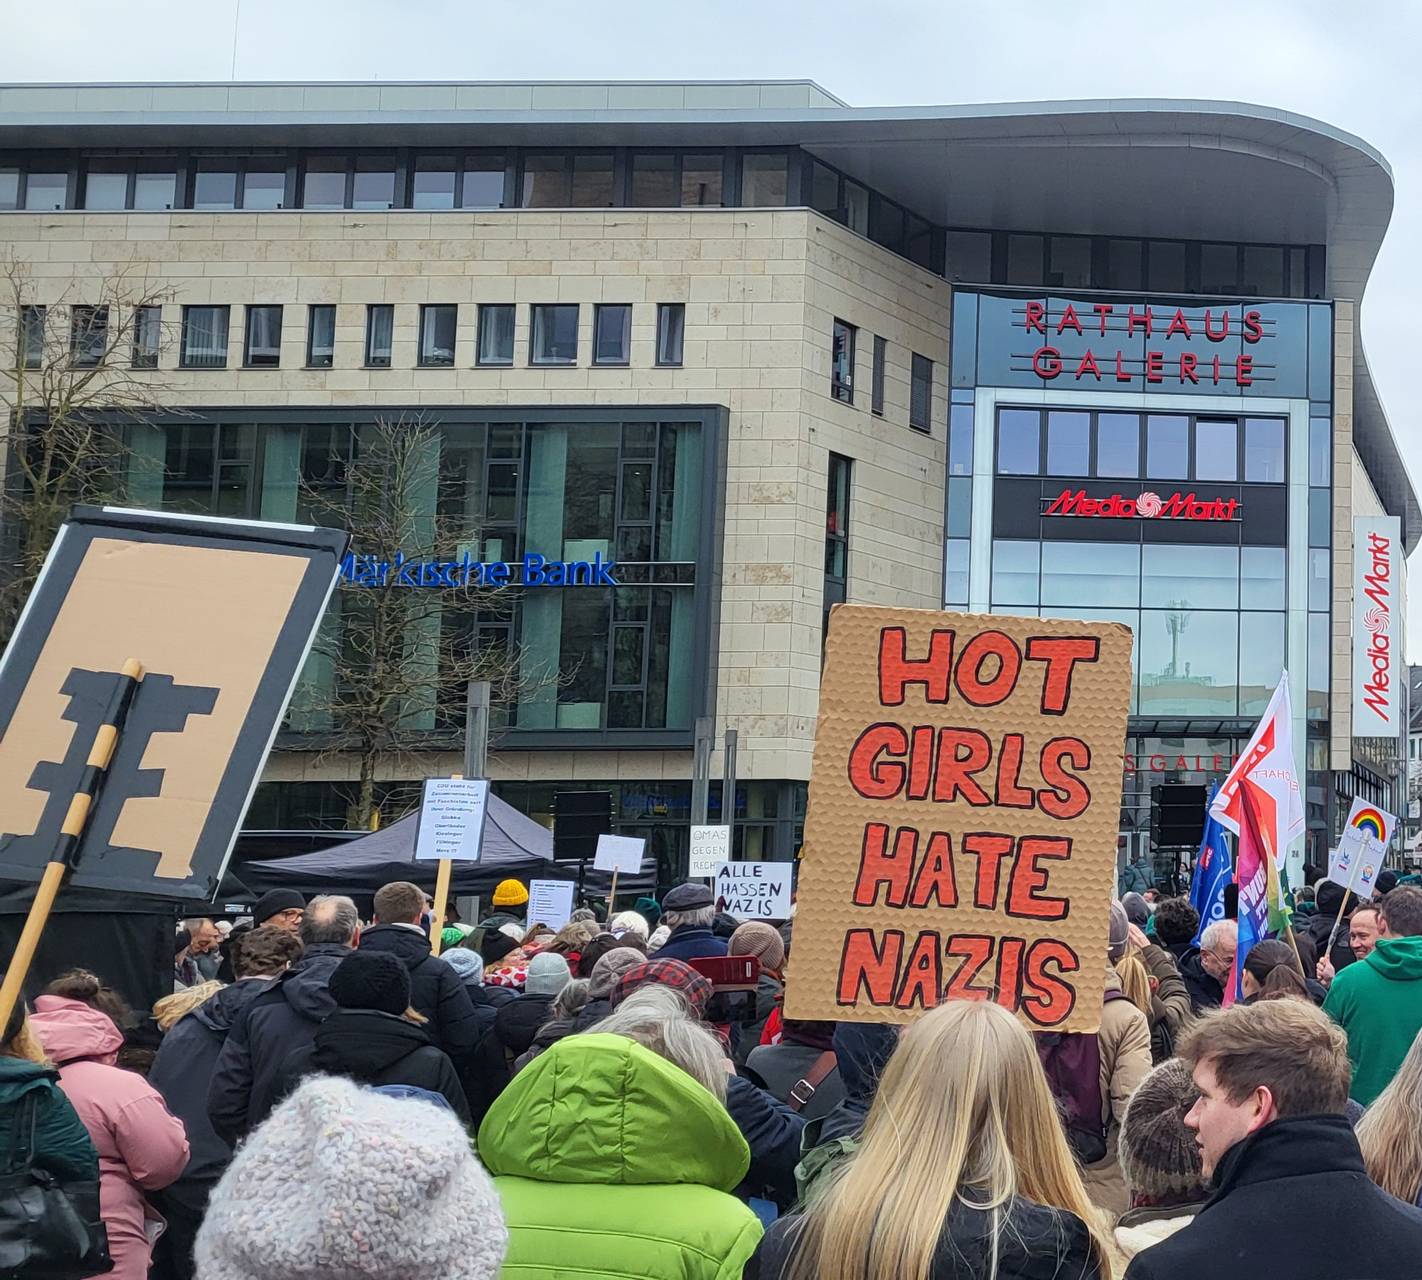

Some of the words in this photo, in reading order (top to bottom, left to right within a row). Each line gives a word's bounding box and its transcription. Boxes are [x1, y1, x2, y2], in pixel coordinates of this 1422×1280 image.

[1026, 301, 1264, 343] RATHAUS
[1032, 346, 1254, 387] GALERIE
[524, 550, 617, 588] Bank
[878, 626, 1100, 716] HOT
[847, 722, 1091, 820] GIRLS
[692, 845, 727, 856] GEGEN
[693, 860, 716, 871] RECH
[719, 865, 763, 879] ALLE
[721, 882, 783, 897] HASSEN
[852, 822, 1073, 921] HATE
[836, 928, 1080, 1026] NAZIS
